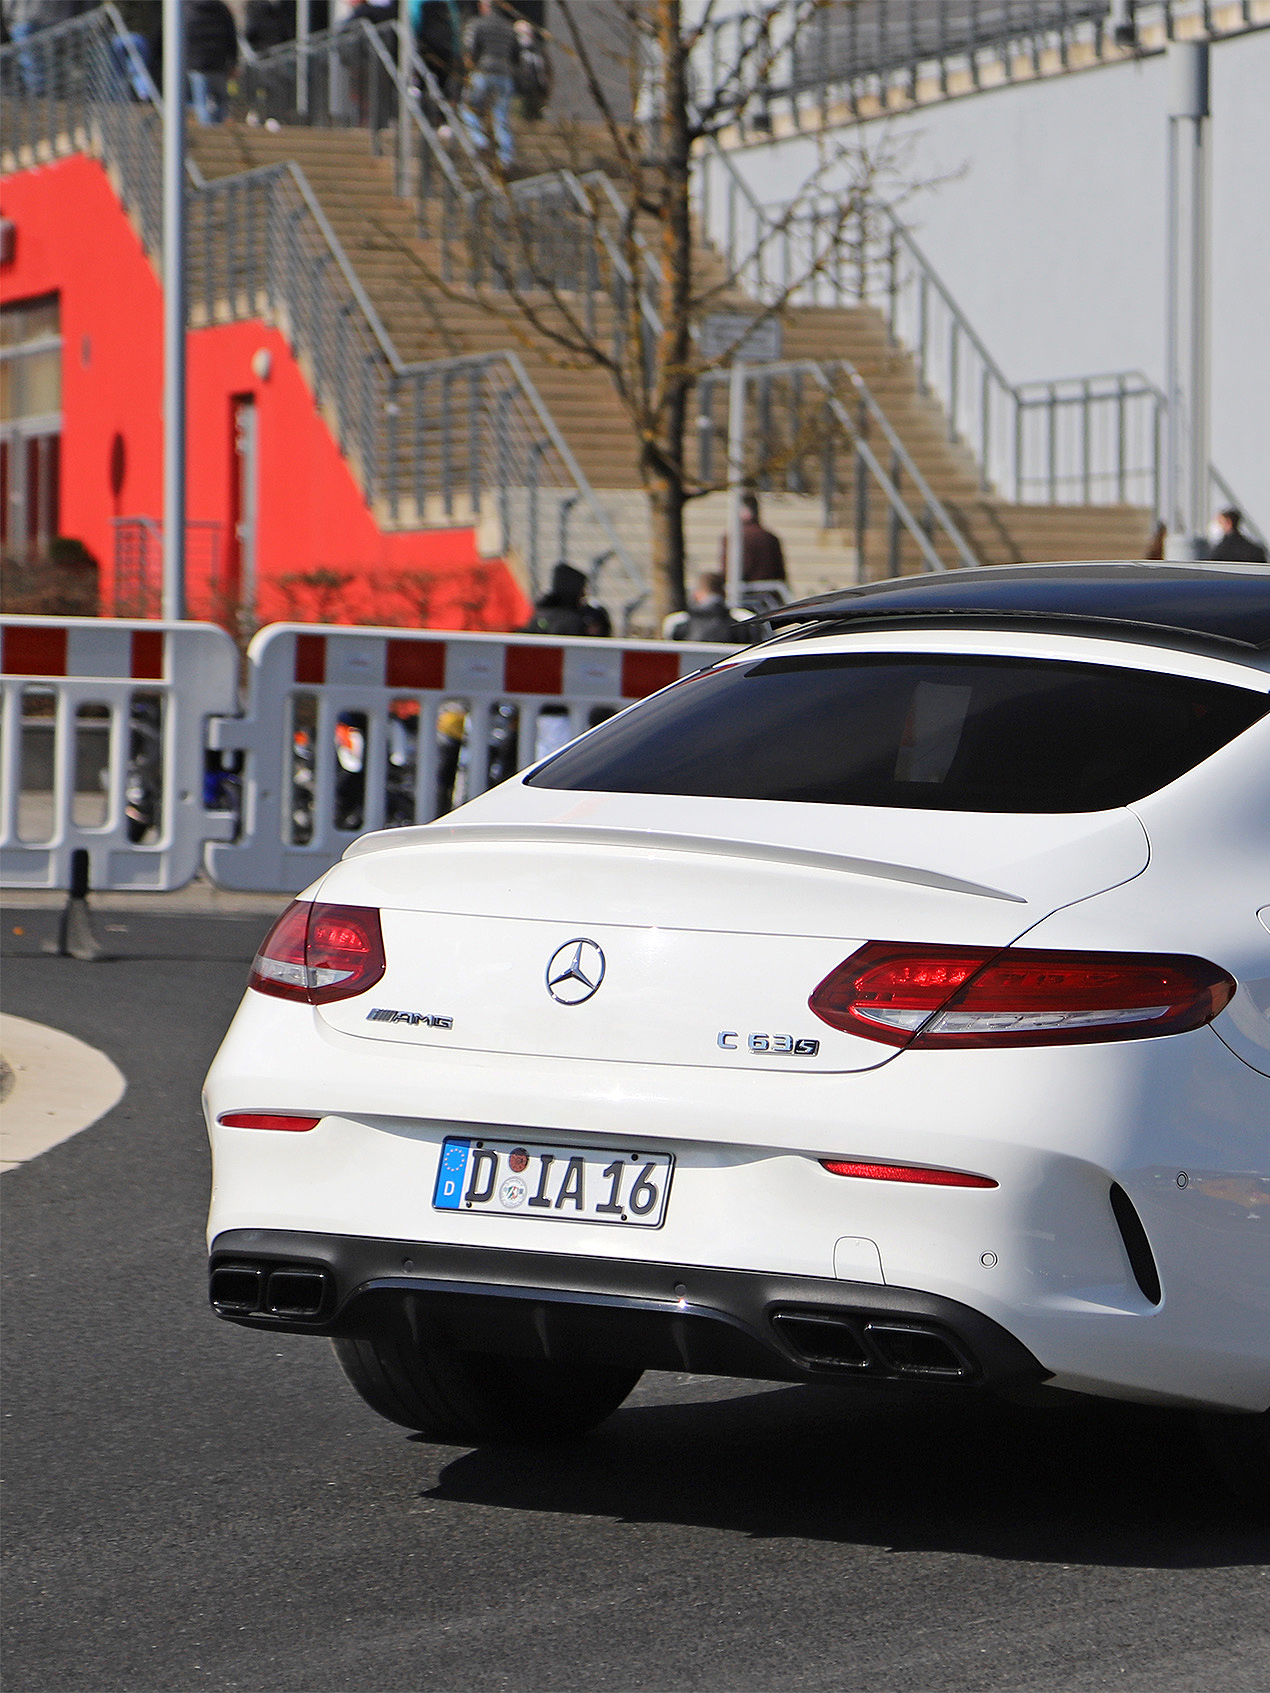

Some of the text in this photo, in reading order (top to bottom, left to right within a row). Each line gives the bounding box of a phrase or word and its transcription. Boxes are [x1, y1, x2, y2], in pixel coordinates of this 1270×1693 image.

[394, 1011, 454, 1030] AMG
[717, 1031, 738, 1049] C
[443, 1180, 455, 1196] D
[465, 1149, 659, 1215] D IA 16
